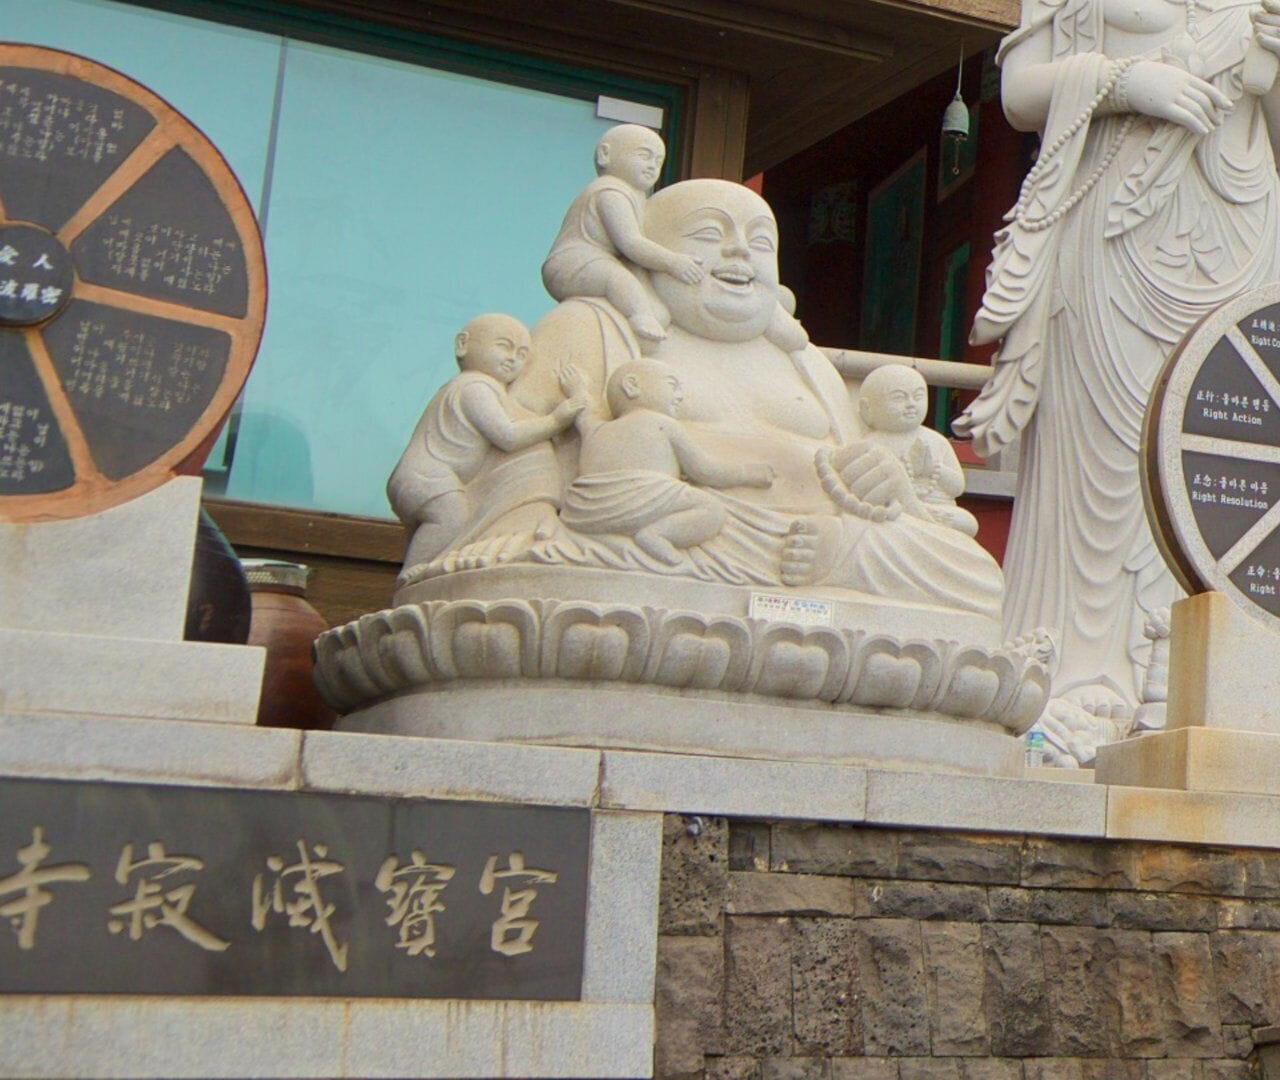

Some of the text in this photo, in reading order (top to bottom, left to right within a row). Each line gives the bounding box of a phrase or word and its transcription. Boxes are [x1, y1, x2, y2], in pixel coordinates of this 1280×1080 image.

[1251, 334, 1271, 348] Right
[1203, 408, 1262, 426] Right Action
[1192, 490, 1269, 510] Right Resolution
[1250, 582, 1275, 596] Right
